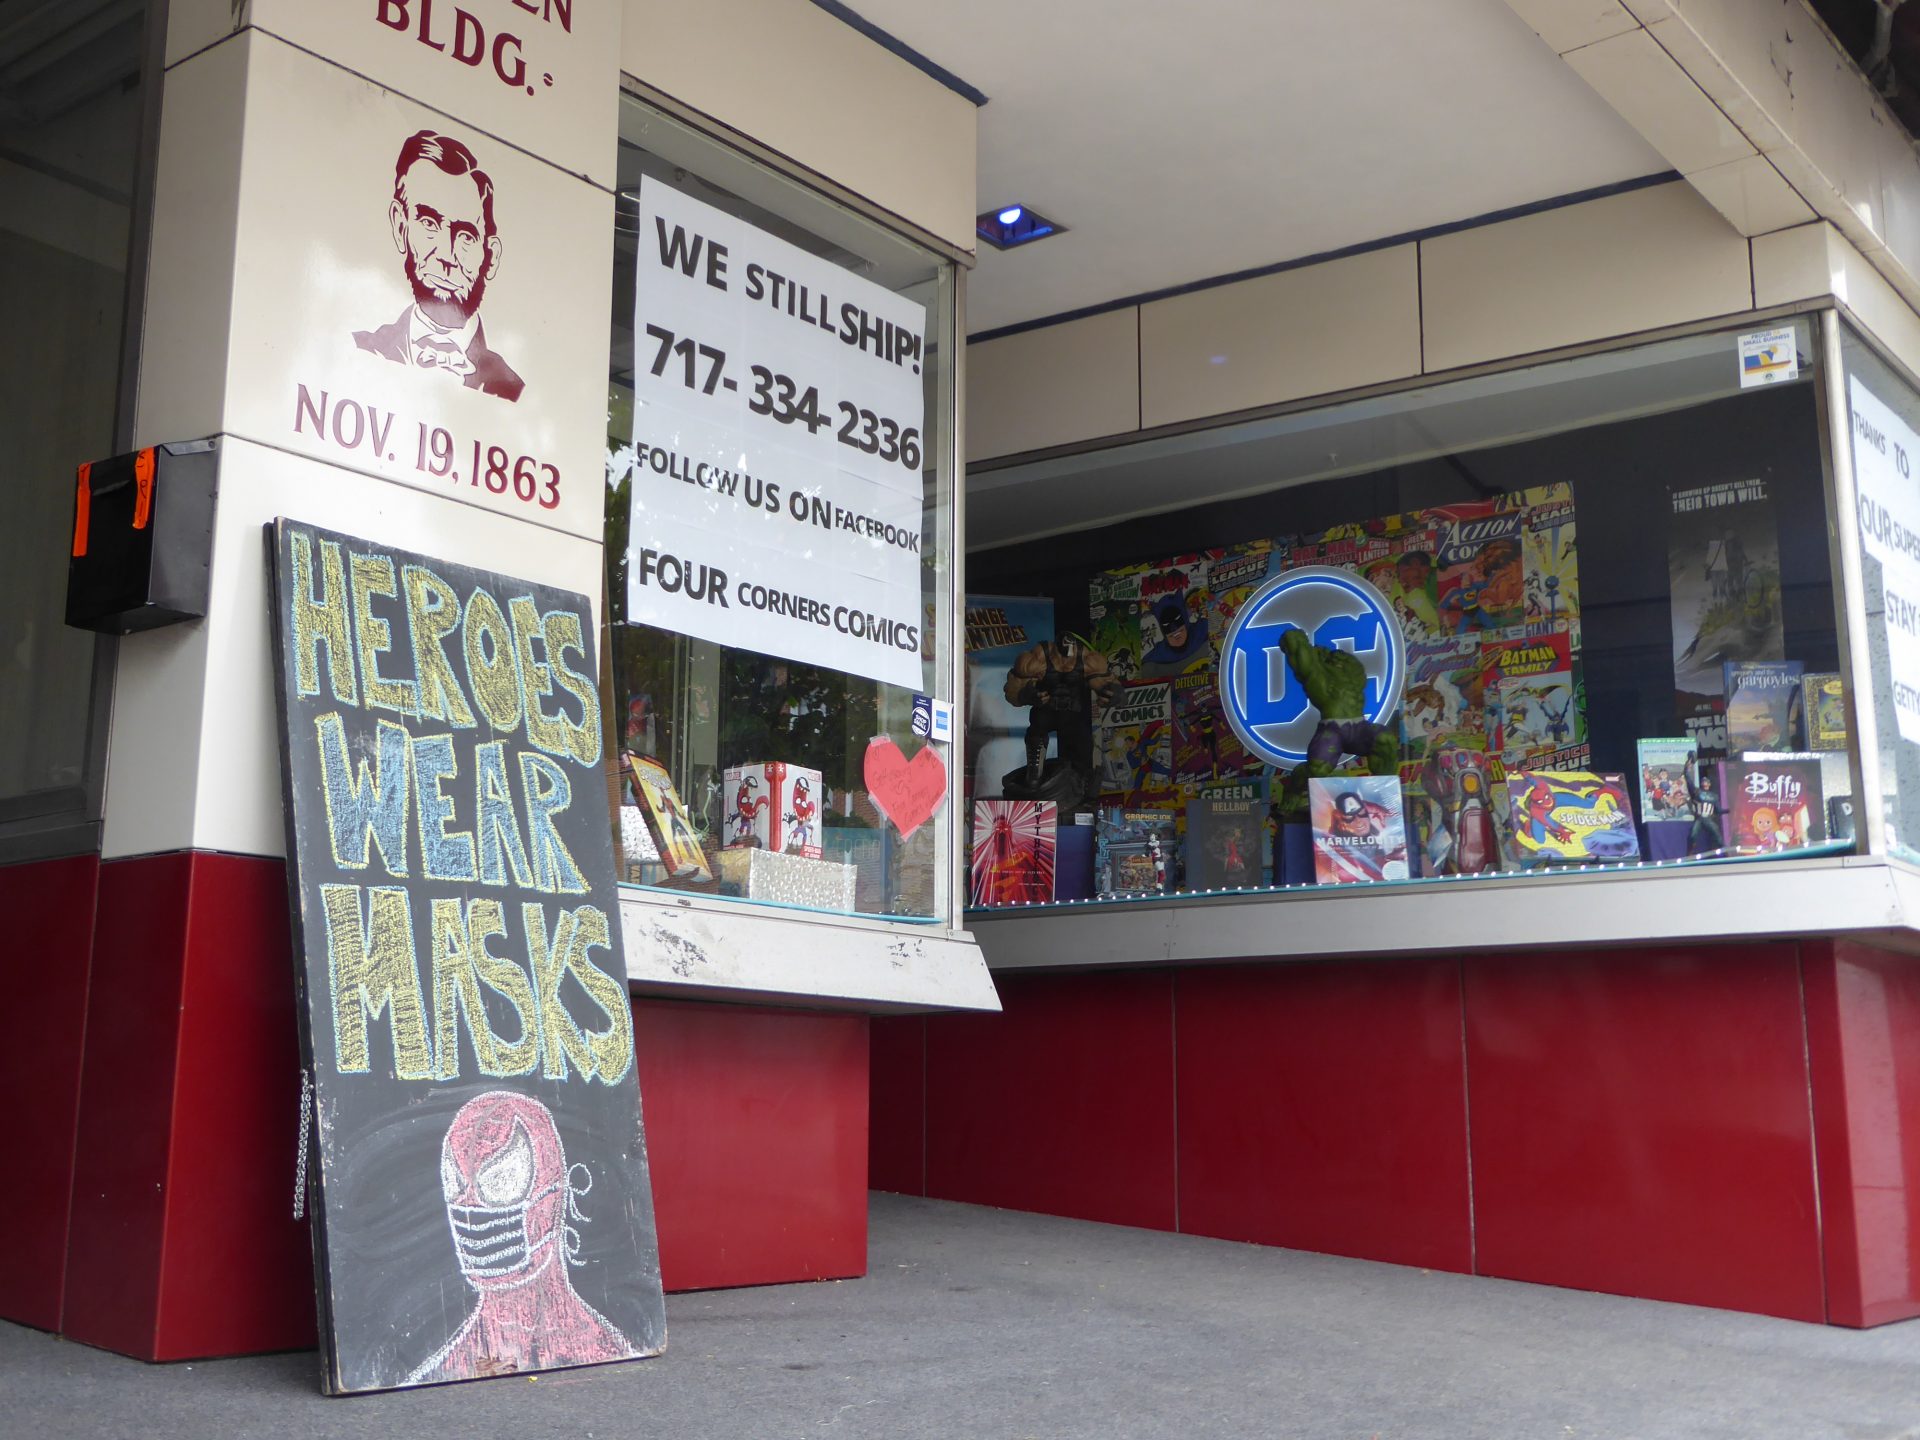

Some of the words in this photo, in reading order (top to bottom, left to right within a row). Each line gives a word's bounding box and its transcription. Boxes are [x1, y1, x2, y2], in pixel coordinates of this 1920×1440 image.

[655, 215, 728, 292] WE
[745, 263, 836, 334] STILL
[293, 383, 395, 461] NOV.
[416, 422, 459, 484] 19,
[471, 440, 561, 510] 1863
[1853, 410, 1886, 456] THANKS
[1893, 440, 1910, 480] TO
[635, 441, 739, 496] FOLLOW
[744, 474, 780, 513] US
[789, 490, 832, 530] ON
[835, 507, 919, 553] FACEBOOK
[1672, 496, 1702, 514] THEIR
[1704, 492, 1736, 509] TOWN
[1738, 486, 1768, 504] WILL.
[1860, 493, 1894, 551] OUR
[1358, 549, 1391, 565] LANTERN
[1403, 539, 1435, 553] LANTERN
[1212, 560, 1265, 585] LEAGUE
[639, 547, 730, 609] FOUR
[737, 582, 831, 627] CORNERS
[833, 605, 919, 654] COMICS
[1886, 589, 1917, 637] STAY
[290, 530, 602, 768] HEROES
[1500, 645, 1557, 667] BATMAN
[1174, 673, 1210, 688] DETECTIVE
[1503, 661, 1552, 676] FAMILY
[1738, 671, 1800, 689] gargoyles
[913, 718, 927, 731] SMALL
[915, 714, 927, 724] SHOP
[1111, 704, 1164, 723] COMICS
[1521, 744, 1591, 770] JUSTICE
[314, 711, 592, 896] WEAR
[1201, 785, 1253, 800] GREEN
[1744, 771, 1801, 811] Buffy
[1125, 813, 1158, 821] GRAPHIC
[1212, 802, 1251, 813] HELLBOY
[1560, 809, 1626, 828] SPIDER-MAN
[320, 883, 634, 1087] MASKS
